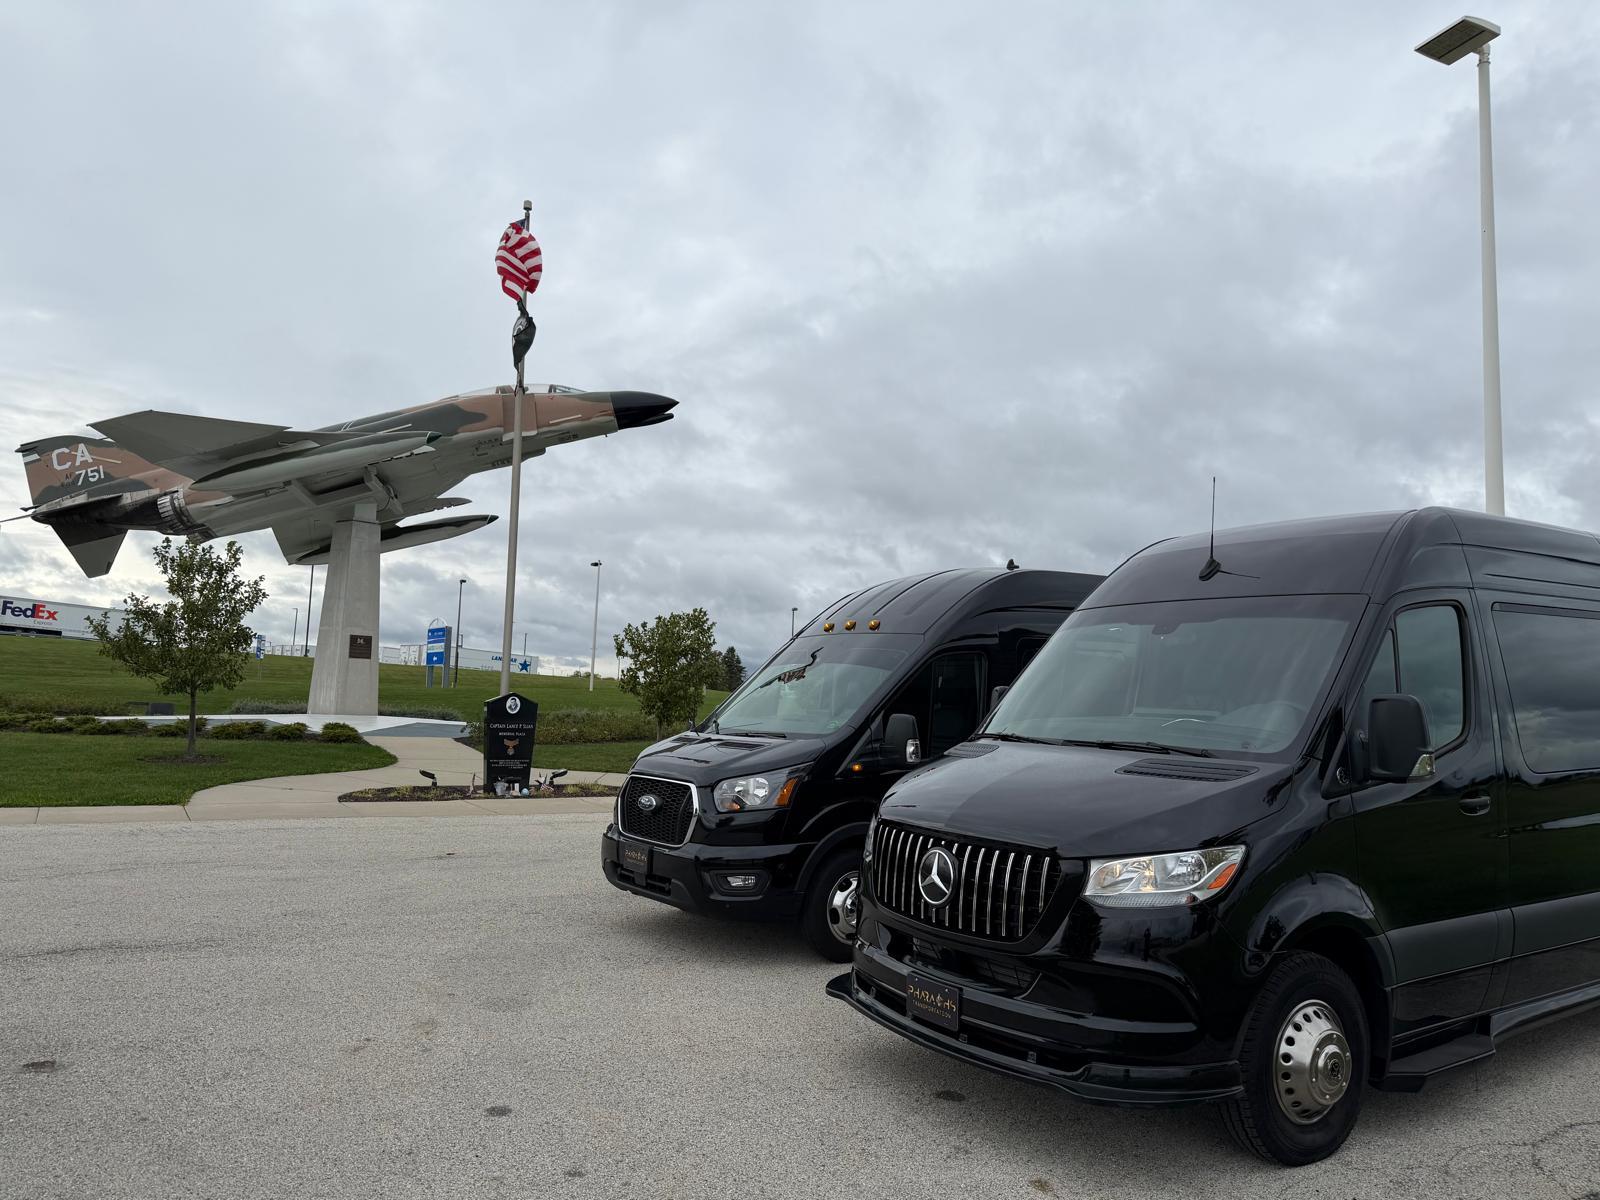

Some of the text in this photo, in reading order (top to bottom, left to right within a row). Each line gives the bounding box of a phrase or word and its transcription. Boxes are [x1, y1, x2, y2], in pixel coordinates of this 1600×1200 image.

[51, 442, 93, 471] CA
[75, 465, 105, 486] 751
[1, 600, 58, 620] FedEx
[491, 655, 517, 663] LANAR
